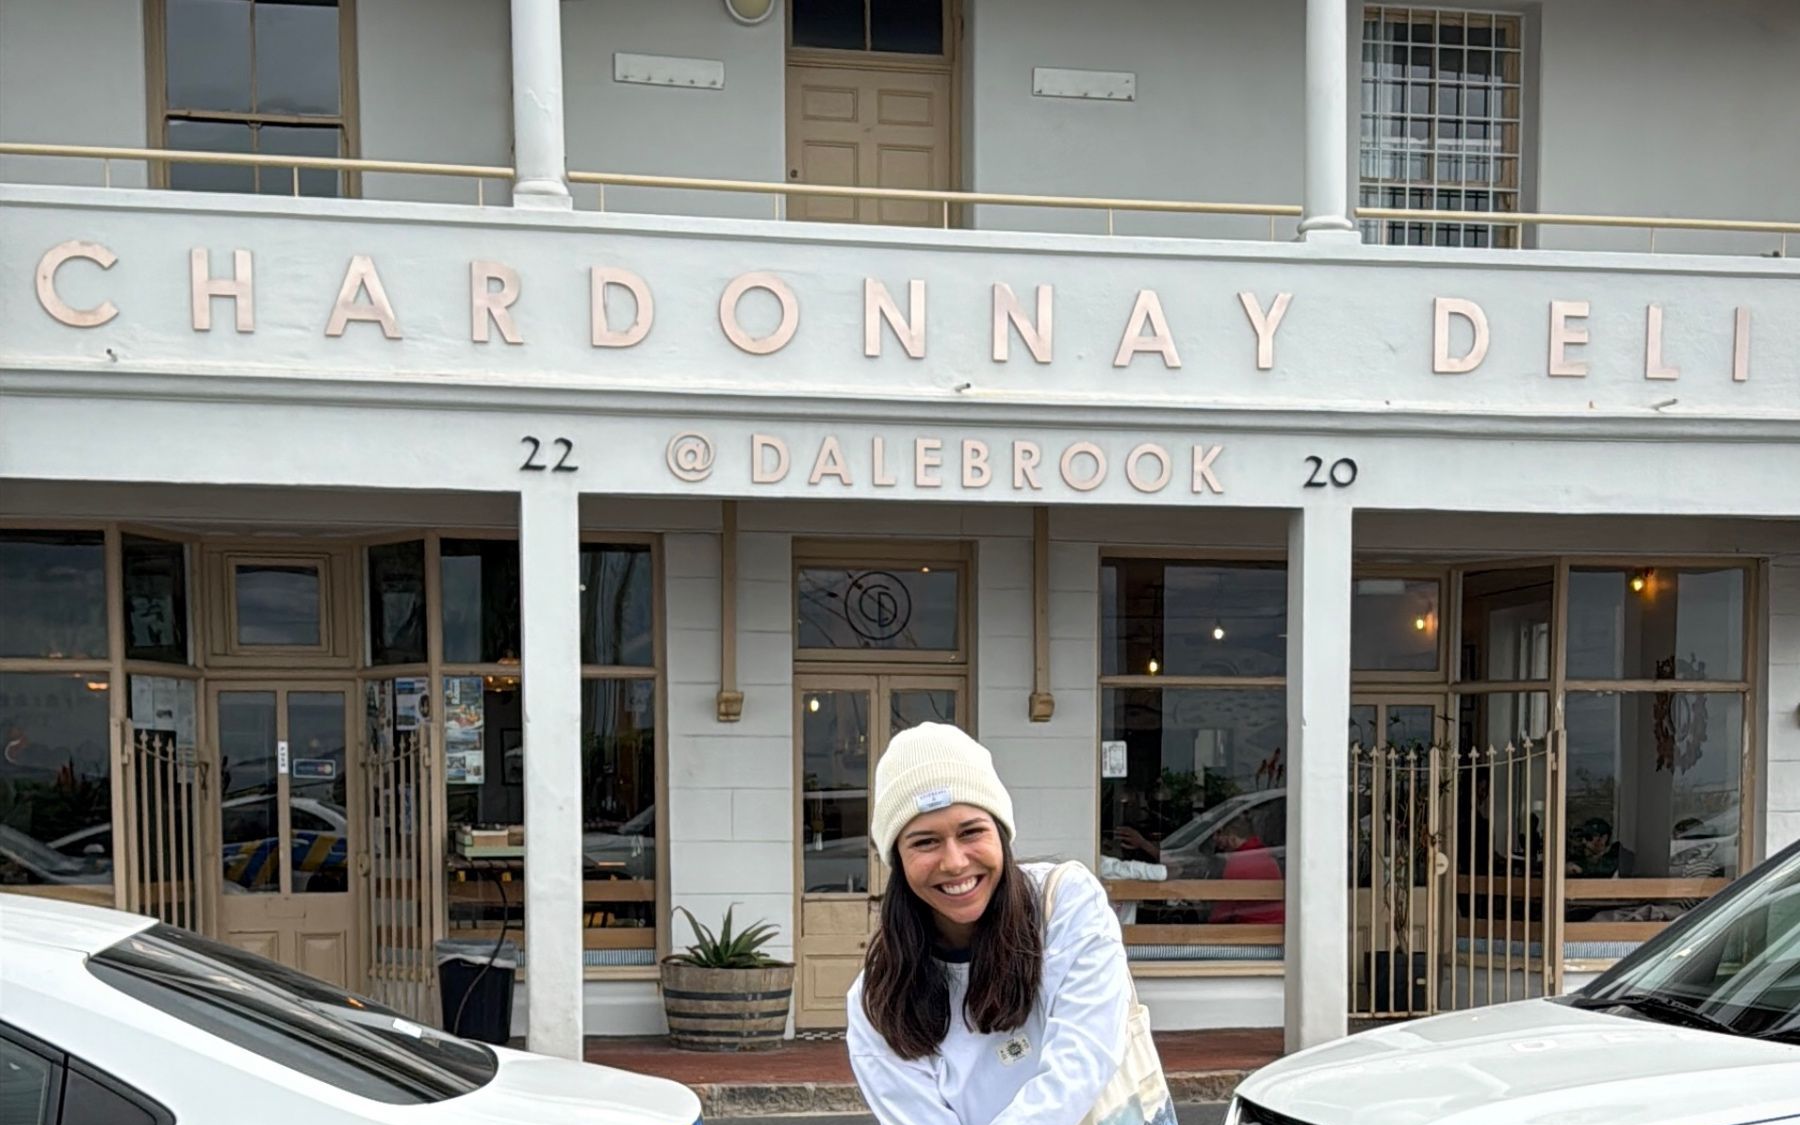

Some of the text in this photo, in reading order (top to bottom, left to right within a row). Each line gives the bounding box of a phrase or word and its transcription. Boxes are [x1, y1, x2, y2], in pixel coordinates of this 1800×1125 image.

[35, 239, 1751, 382] CHARDONNAY DELI
[519, 435, 579, 474] 22
[665, 431, 1225, 494] @ DALEBROOK
[1302, 455, 1358, 490] 20
